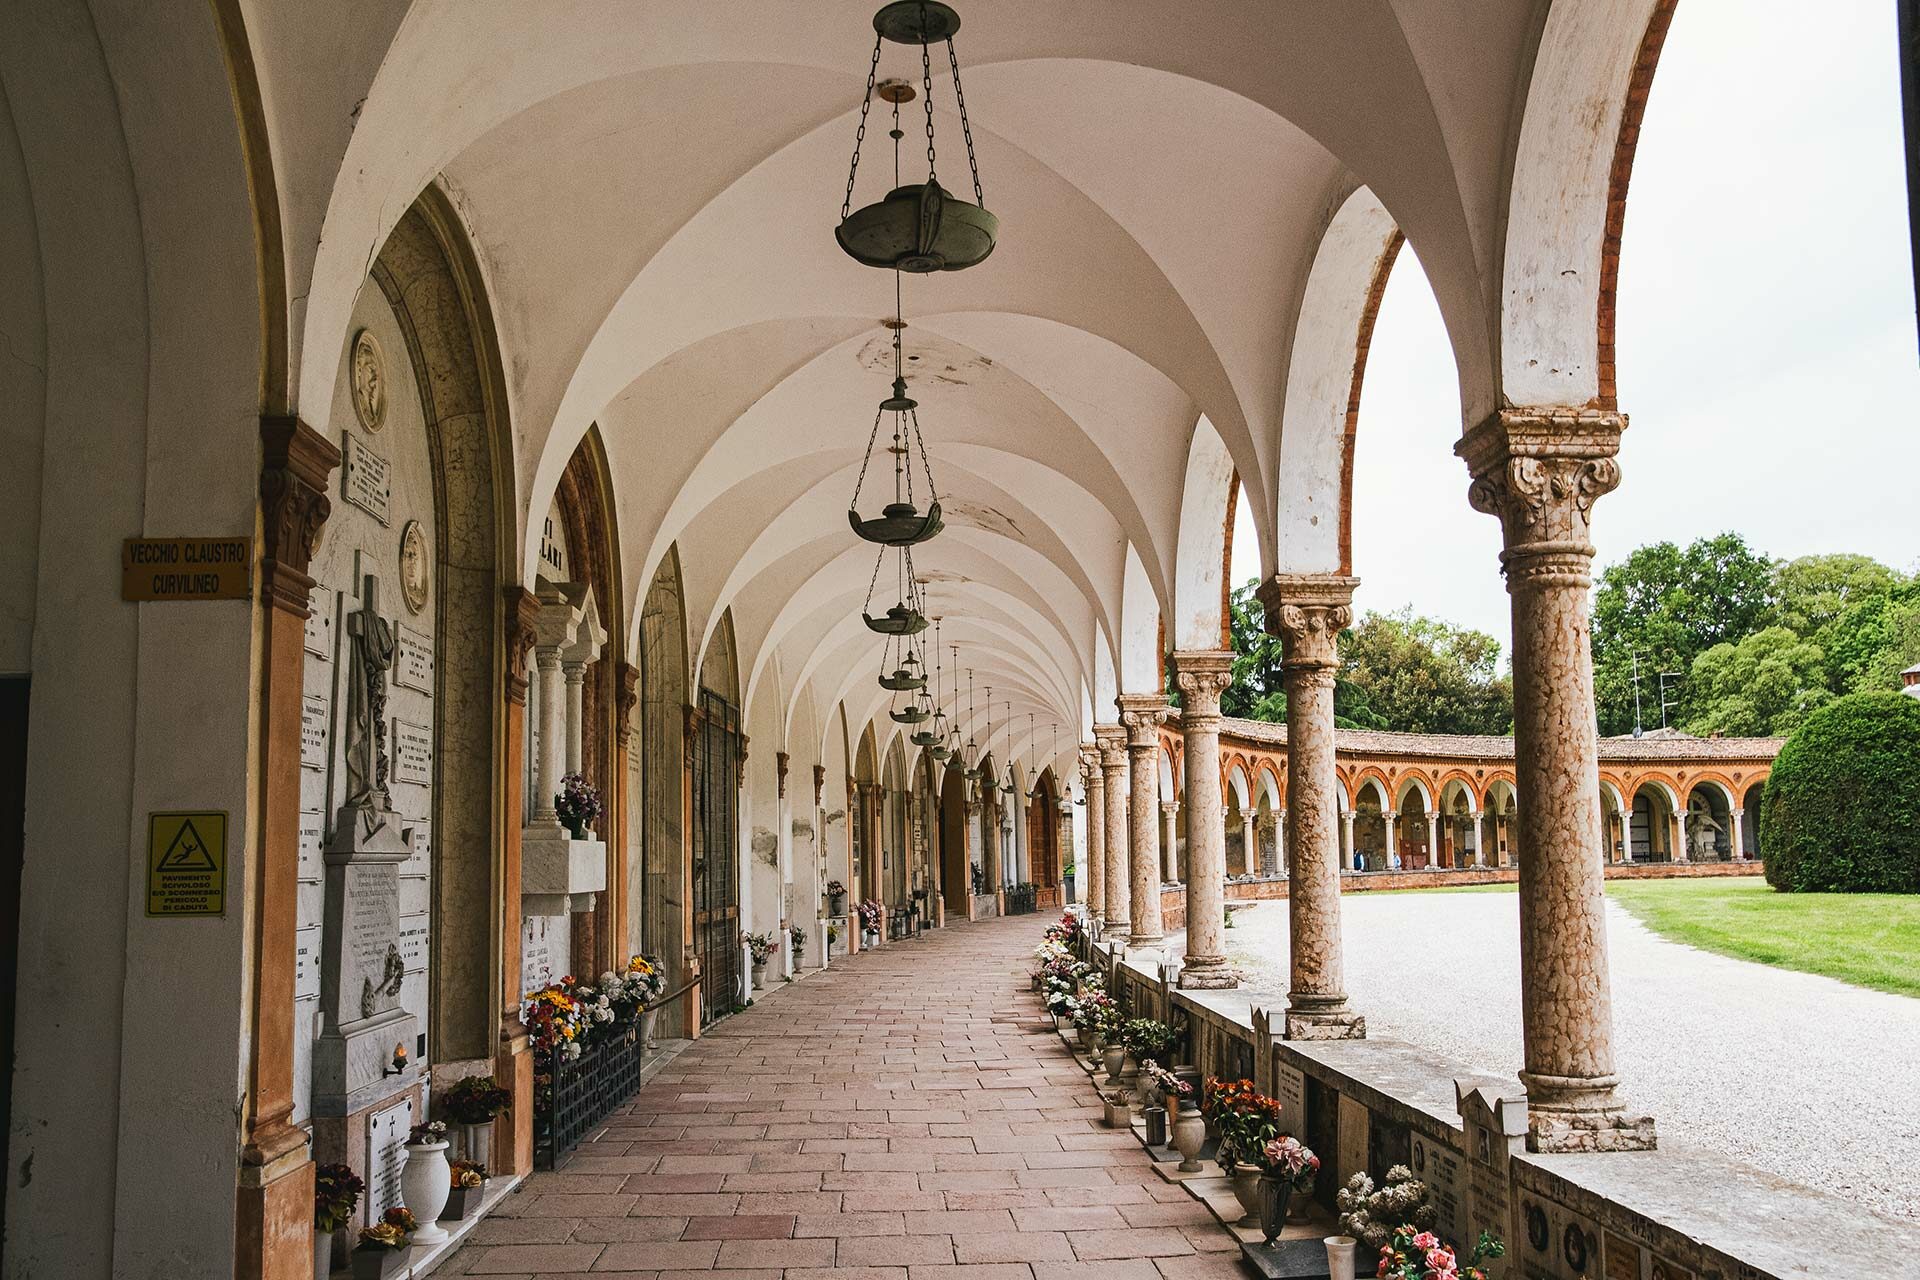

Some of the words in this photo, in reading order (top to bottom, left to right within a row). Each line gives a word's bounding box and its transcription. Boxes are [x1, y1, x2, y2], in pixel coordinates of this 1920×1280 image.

[130, 544, 179, 564] VECCHIO
[185, 543, 245, 563] CLAUSTRO
[153, 574, 219, 594] CURVILINEO
